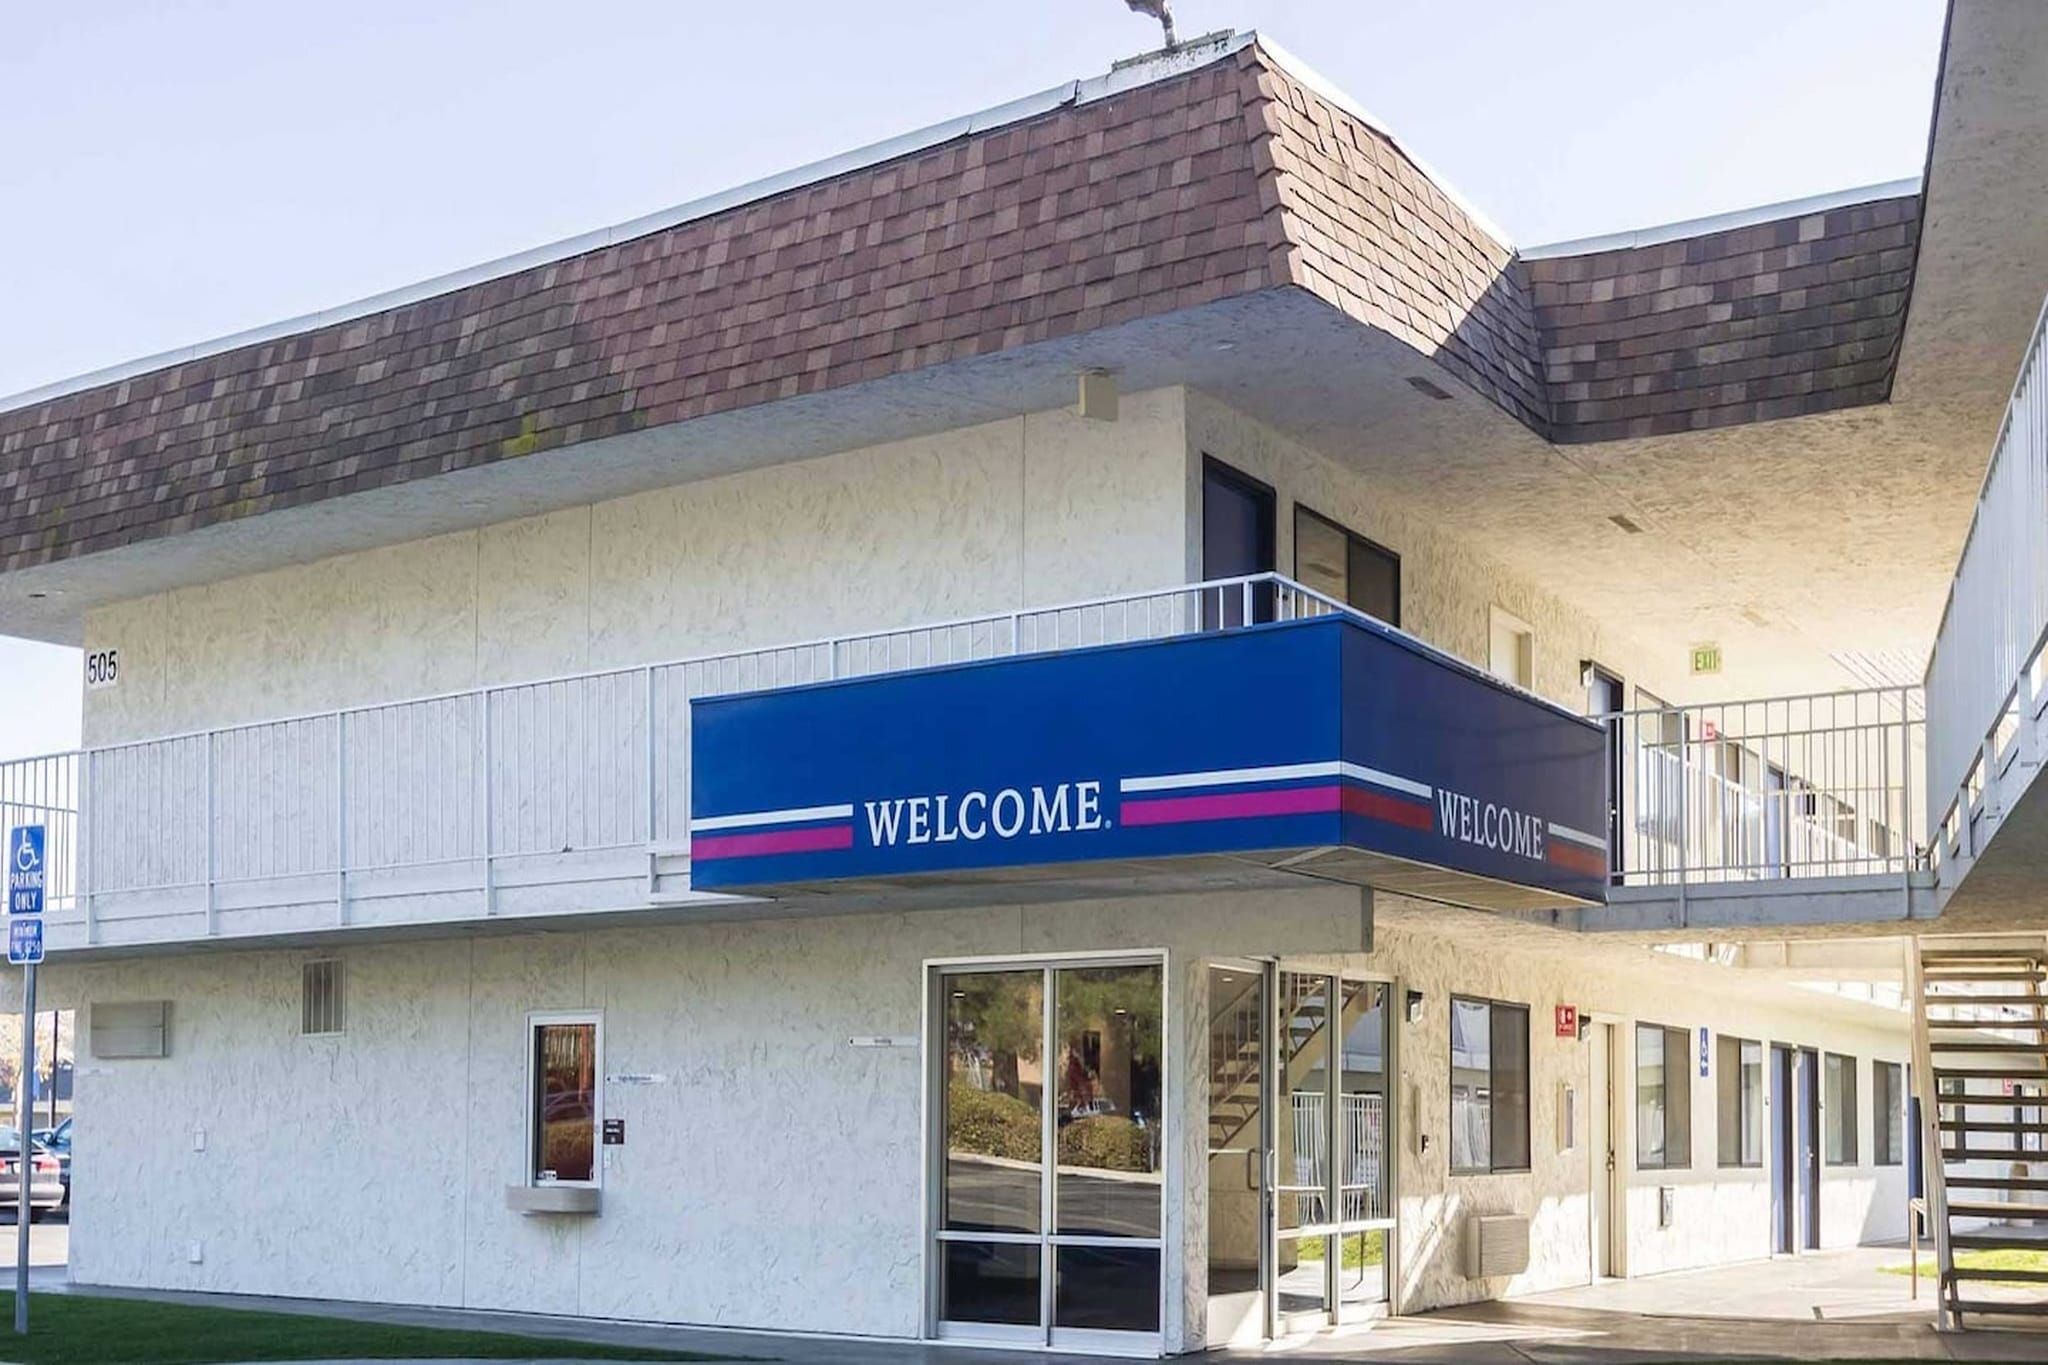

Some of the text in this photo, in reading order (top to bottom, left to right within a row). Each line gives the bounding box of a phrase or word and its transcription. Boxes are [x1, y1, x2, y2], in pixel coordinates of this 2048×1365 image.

[88, 650, 117, 684] 505
[1695, 651, 1718, 671] EXIT
[1437, 788, 1543, 861] WELCOME
[10, 870, 42, 891] PARKING
[15, 890, 37, 911] ONLY
